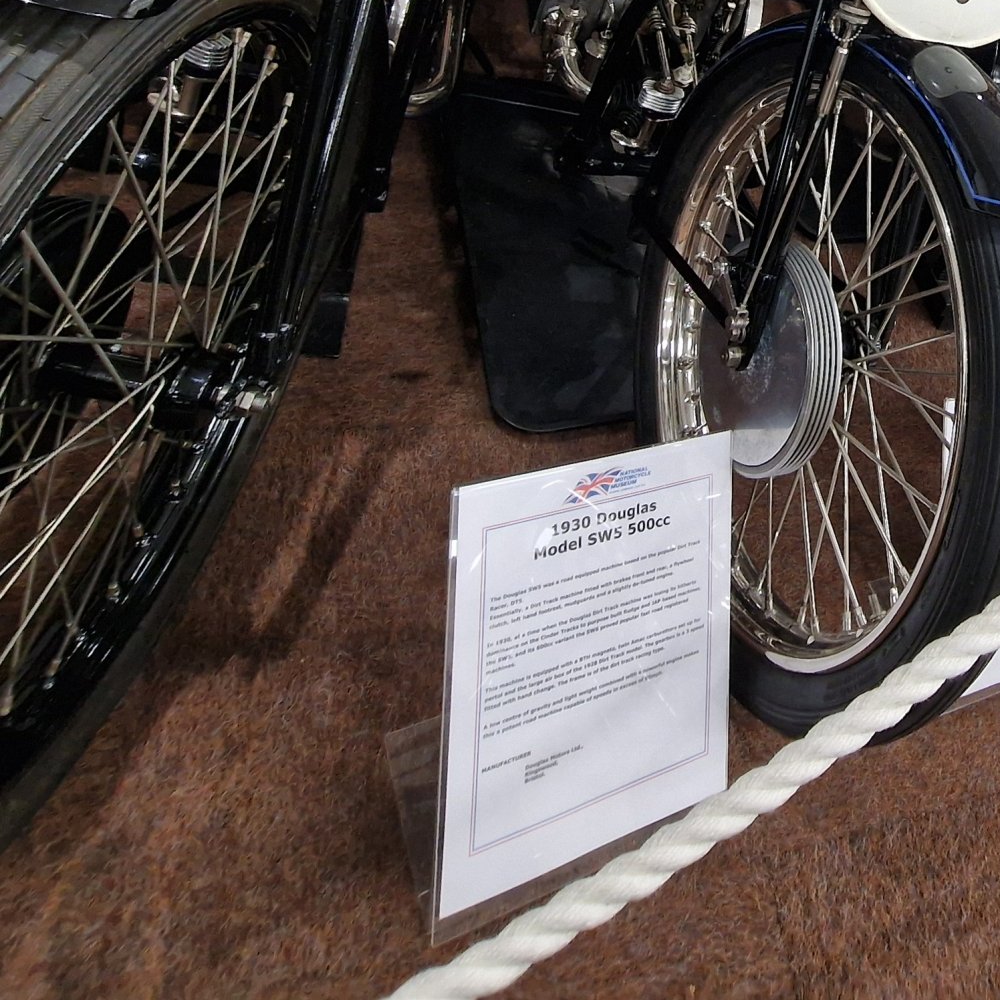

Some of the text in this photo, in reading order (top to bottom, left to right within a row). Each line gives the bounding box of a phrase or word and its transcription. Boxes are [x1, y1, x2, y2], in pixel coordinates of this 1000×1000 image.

[610, 479, 638, 489] MUSEUM
[552, 502, 656, 536] 1930 Douglas
[534, 515, 670, 559] Model SW5 500cc
